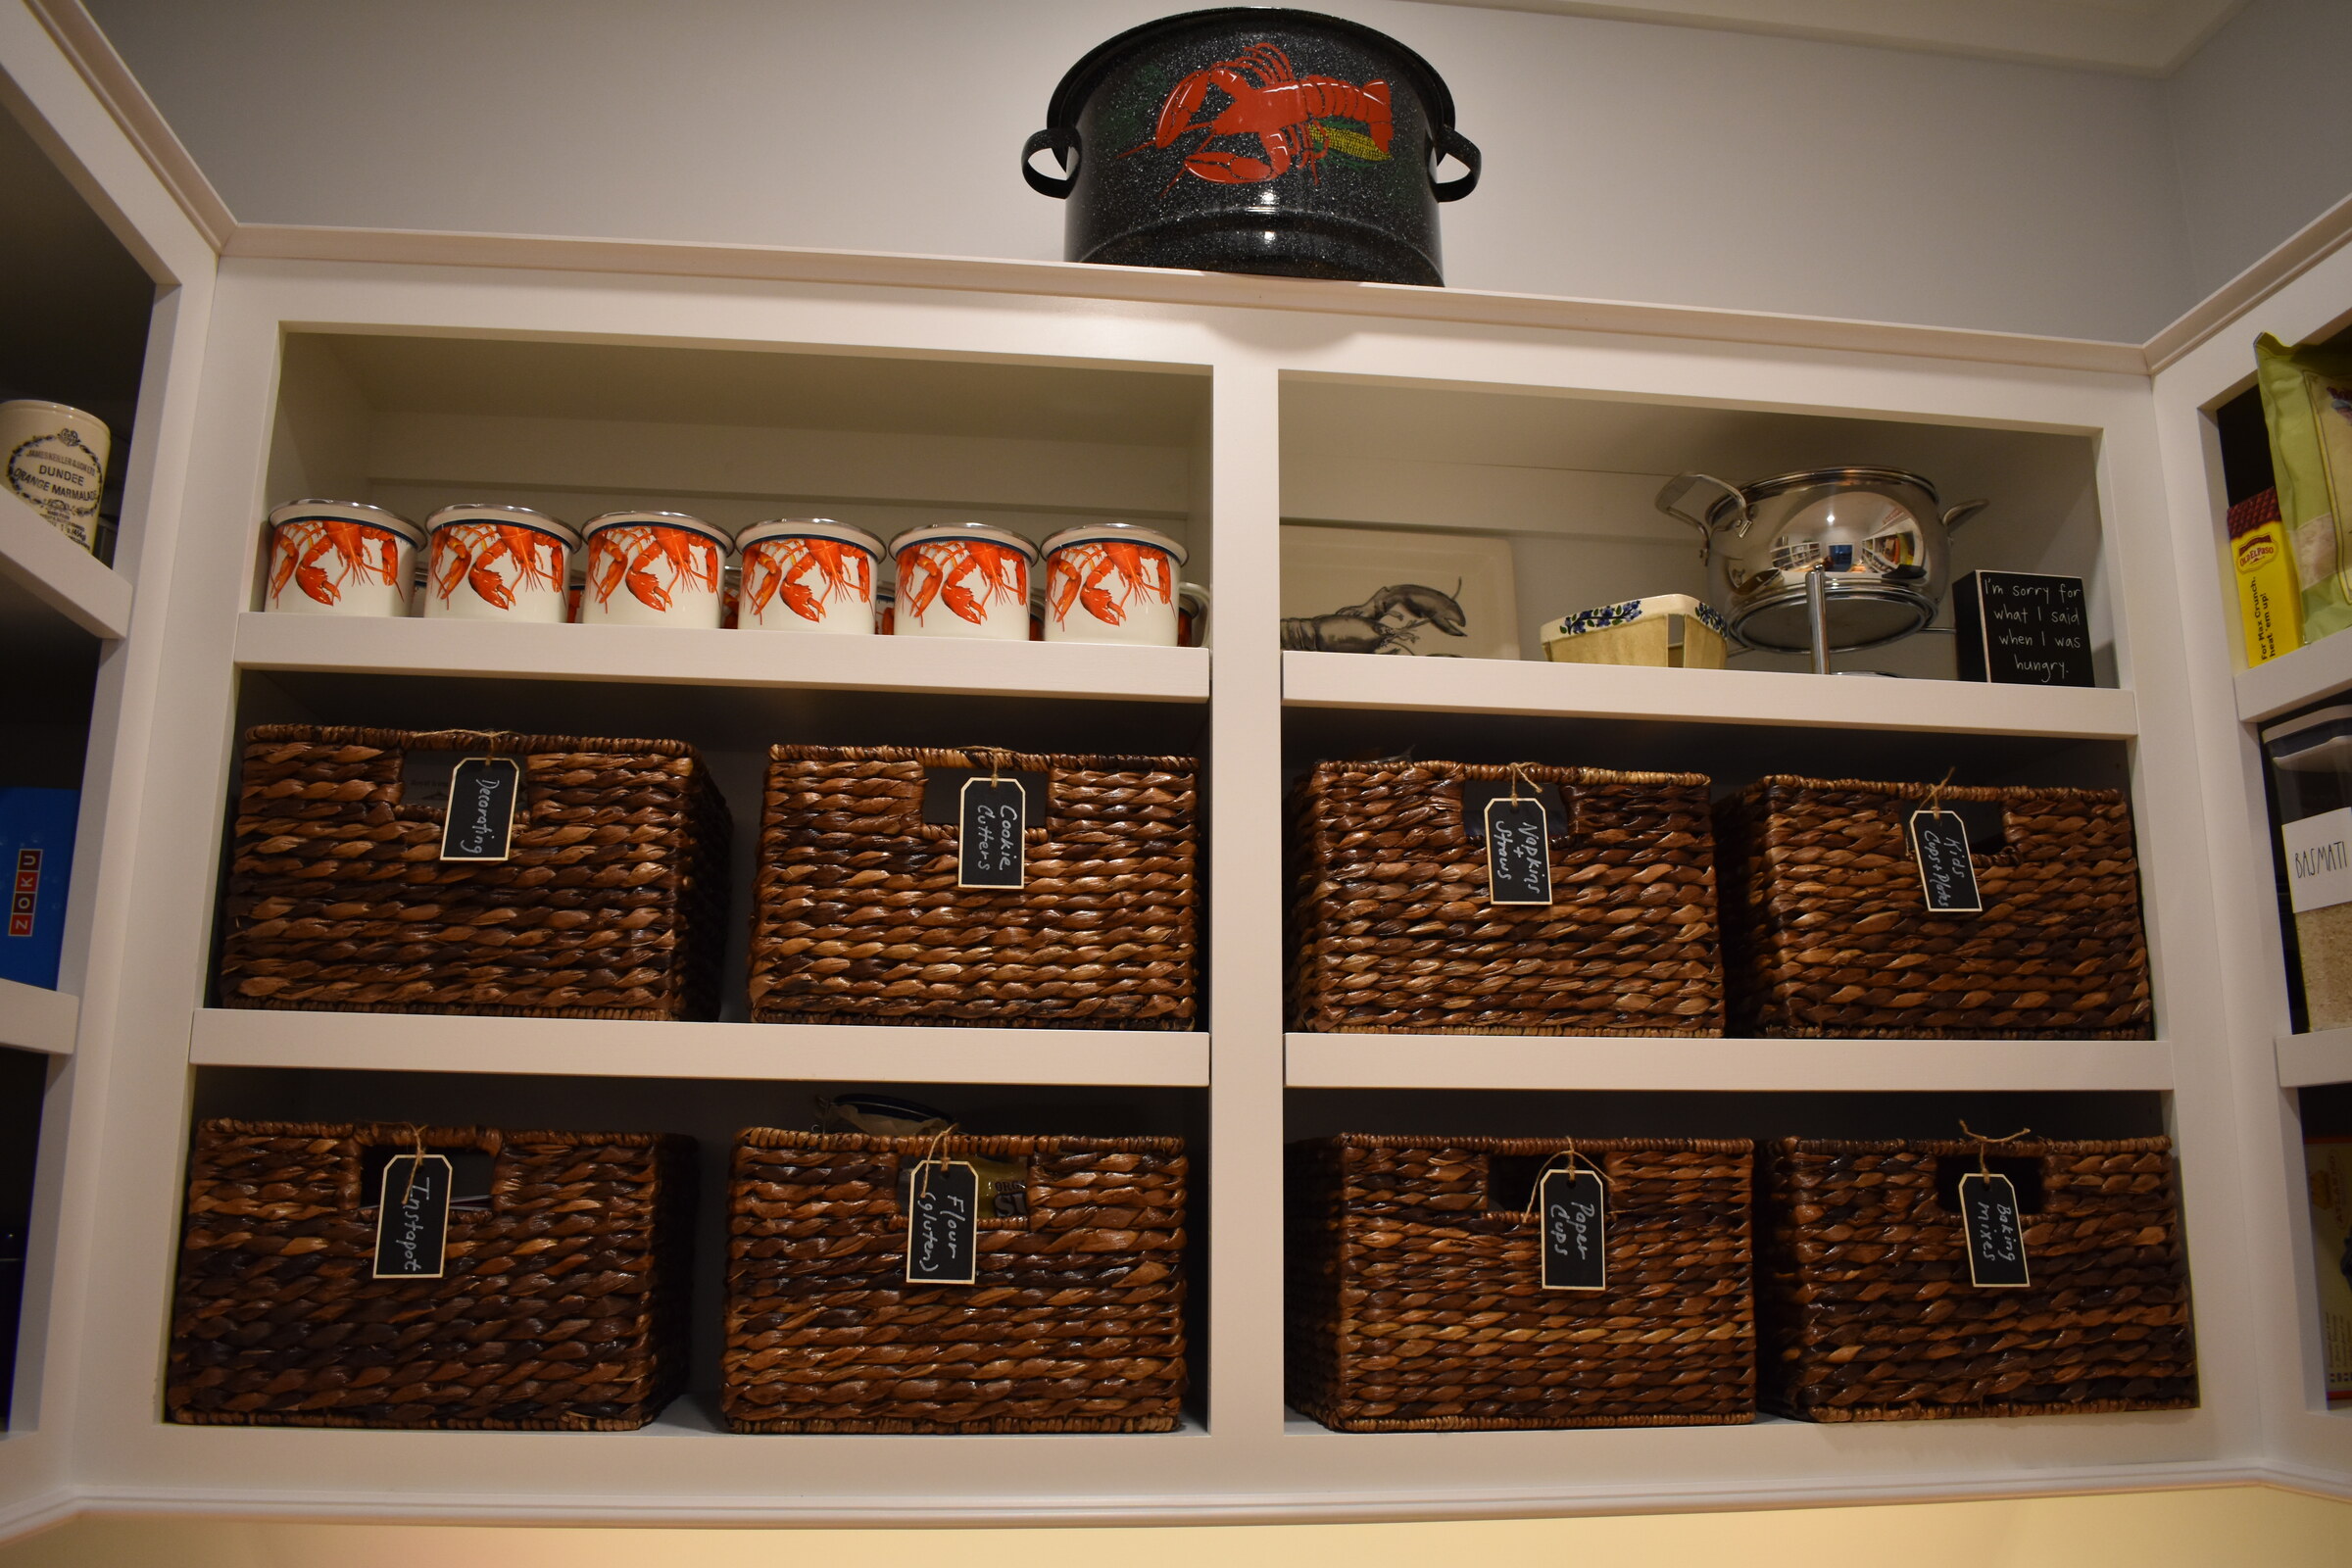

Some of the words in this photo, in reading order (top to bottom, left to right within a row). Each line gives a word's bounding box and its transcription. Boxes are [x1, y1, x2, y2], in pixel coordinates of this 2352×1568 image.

[14, 467, 50, 491] ORANGE
[52, 484, 98, 501] MARMALADE
[39, 465, 84, 486] DUNDEE
[1984, 577, 2003, 595] I'm
[2012, 585, 2049, 605] sorry
[2058, 583, 2081, 604] for
[1993, 603, 2029, 624] what
[2037, 606, 2042, 621] I
[2051, 607, 2081, 625] said
[2250, 576, 2261, 618] Crunch.
[2260, 592, 2269, 610] up!
[1999, 628, 2033, 646] when
[2041, 630, 2046, 647] I
[2054, 636, 2081, 648] was
[2267, 632, 2276, 658] heat
[2014, 653, 2069, 683] hungry.
[460, 778, 501, 854] Decorating
[977, 805, 997, 871] Cutters
[999, 805, 1018, 871] Cookie
[1494, 820, 1513, 880] Straws
[1518, 821, 1545, 894] Napkins
[1924, 830, 1941, 863] Cups
[1943, 836, 1966, 878] Kids
[2294, 840, 2348, 879] BASMATI
[14, 854, 37, 931] ZOKU
[395, 1177, 430, 1271] Instapot
[917, 1192, 939, 1272] (gluten)
[940, 1195, 965, 1259] Flour
[1550, 1203, 1571, 1255] Cups
[1566, 1201, 1595, 1260] Paper
[1997, 1203, 2017, 1261] Baking
